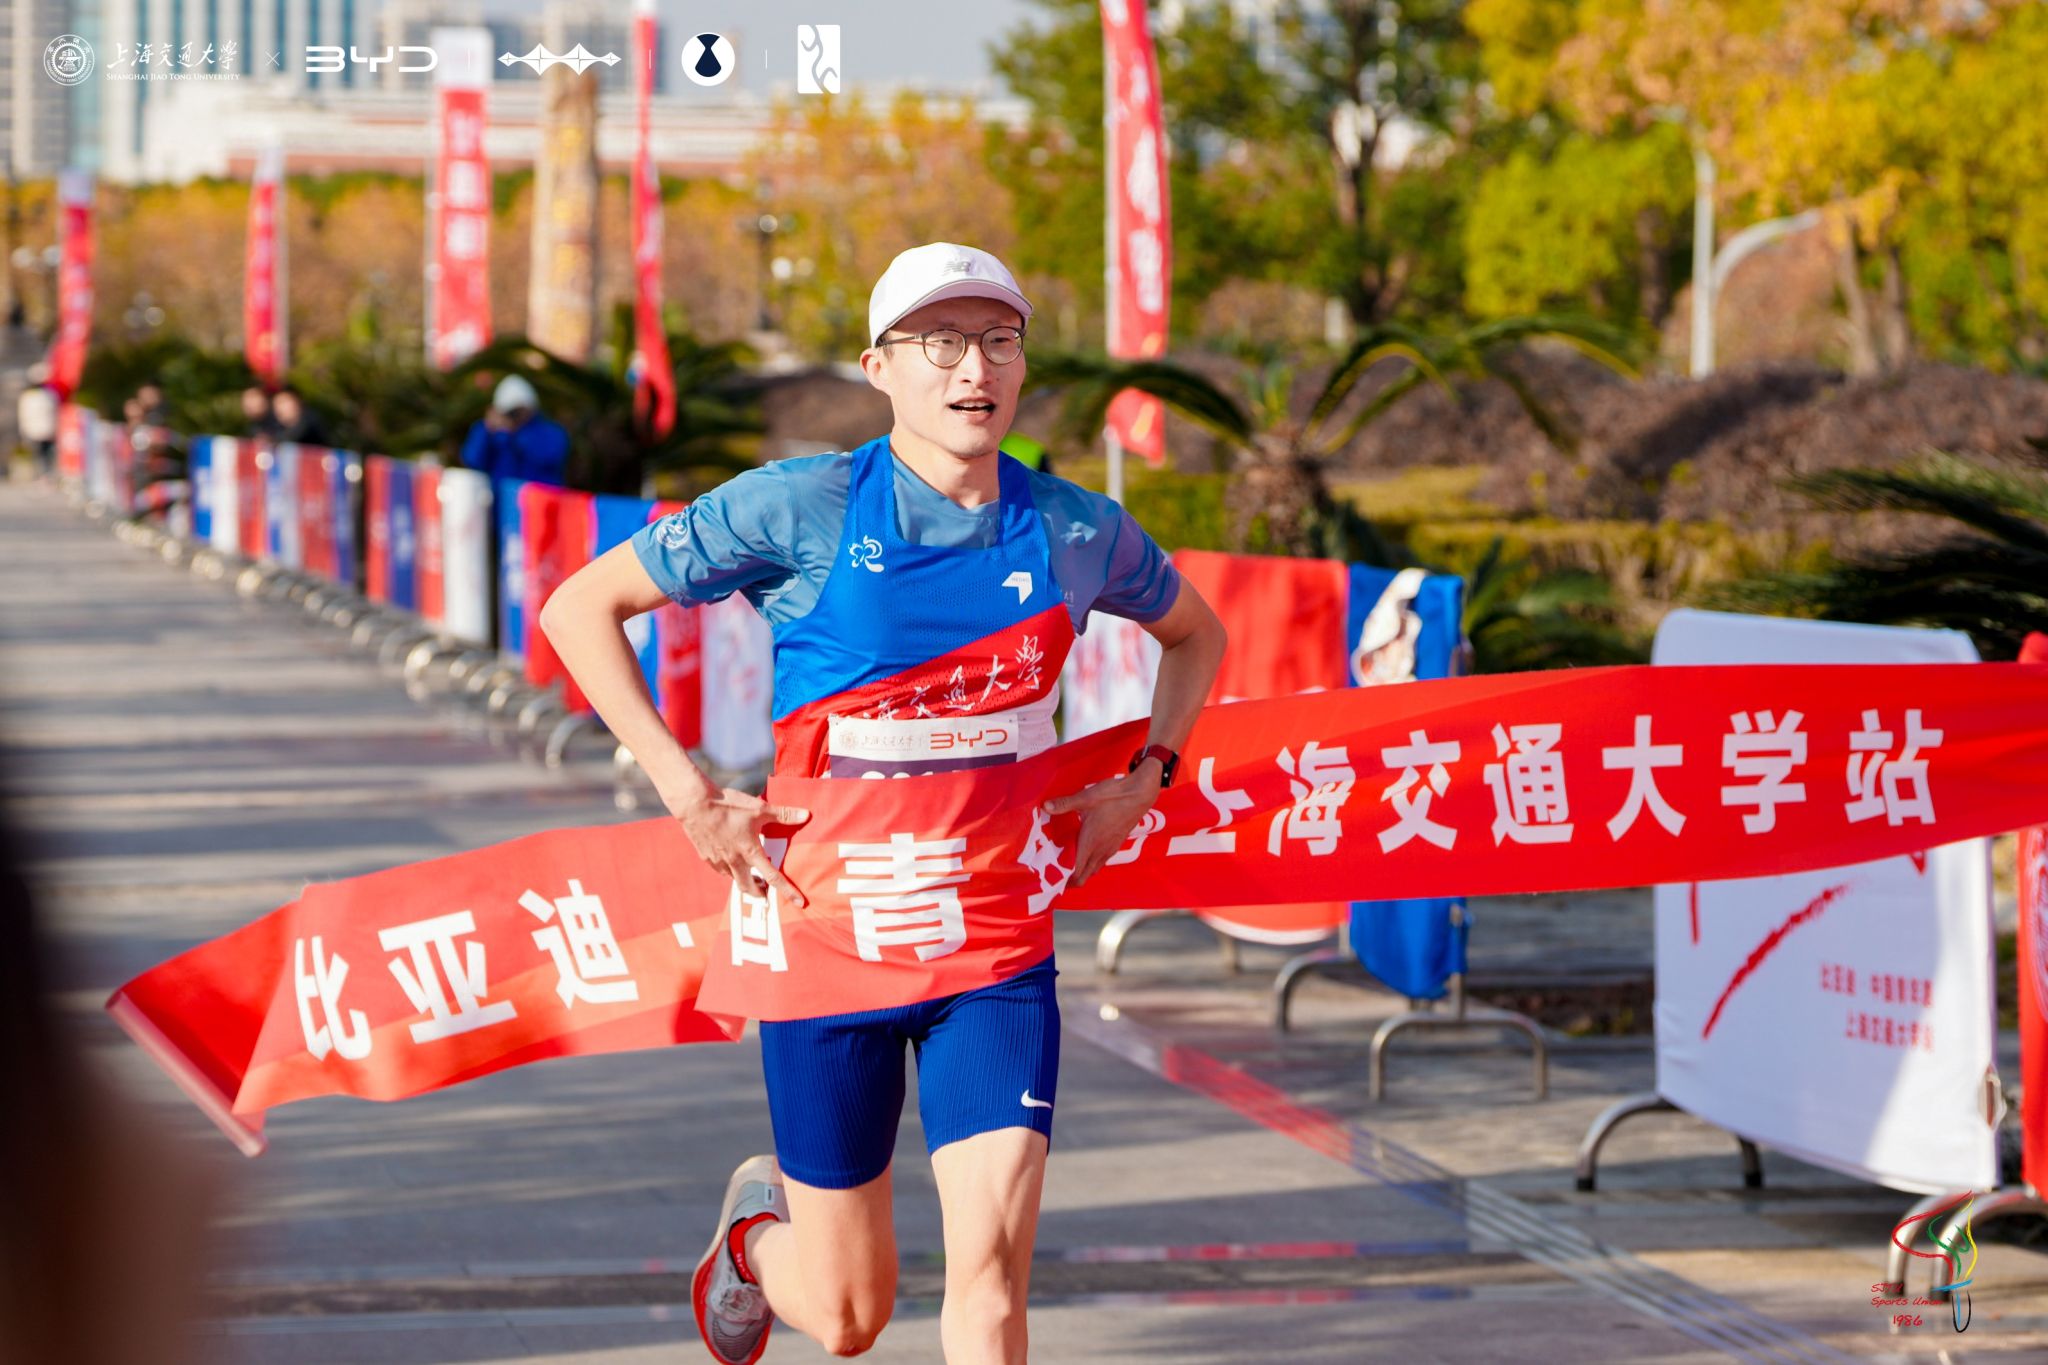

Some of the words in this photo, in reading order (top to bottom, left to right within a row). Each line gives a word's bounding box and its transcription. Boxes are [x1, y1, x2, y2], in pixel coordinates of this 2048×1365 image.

[930, 729, 1008, 750] BYD
[1166, 708, 1945, 857] 上海交通大学站
